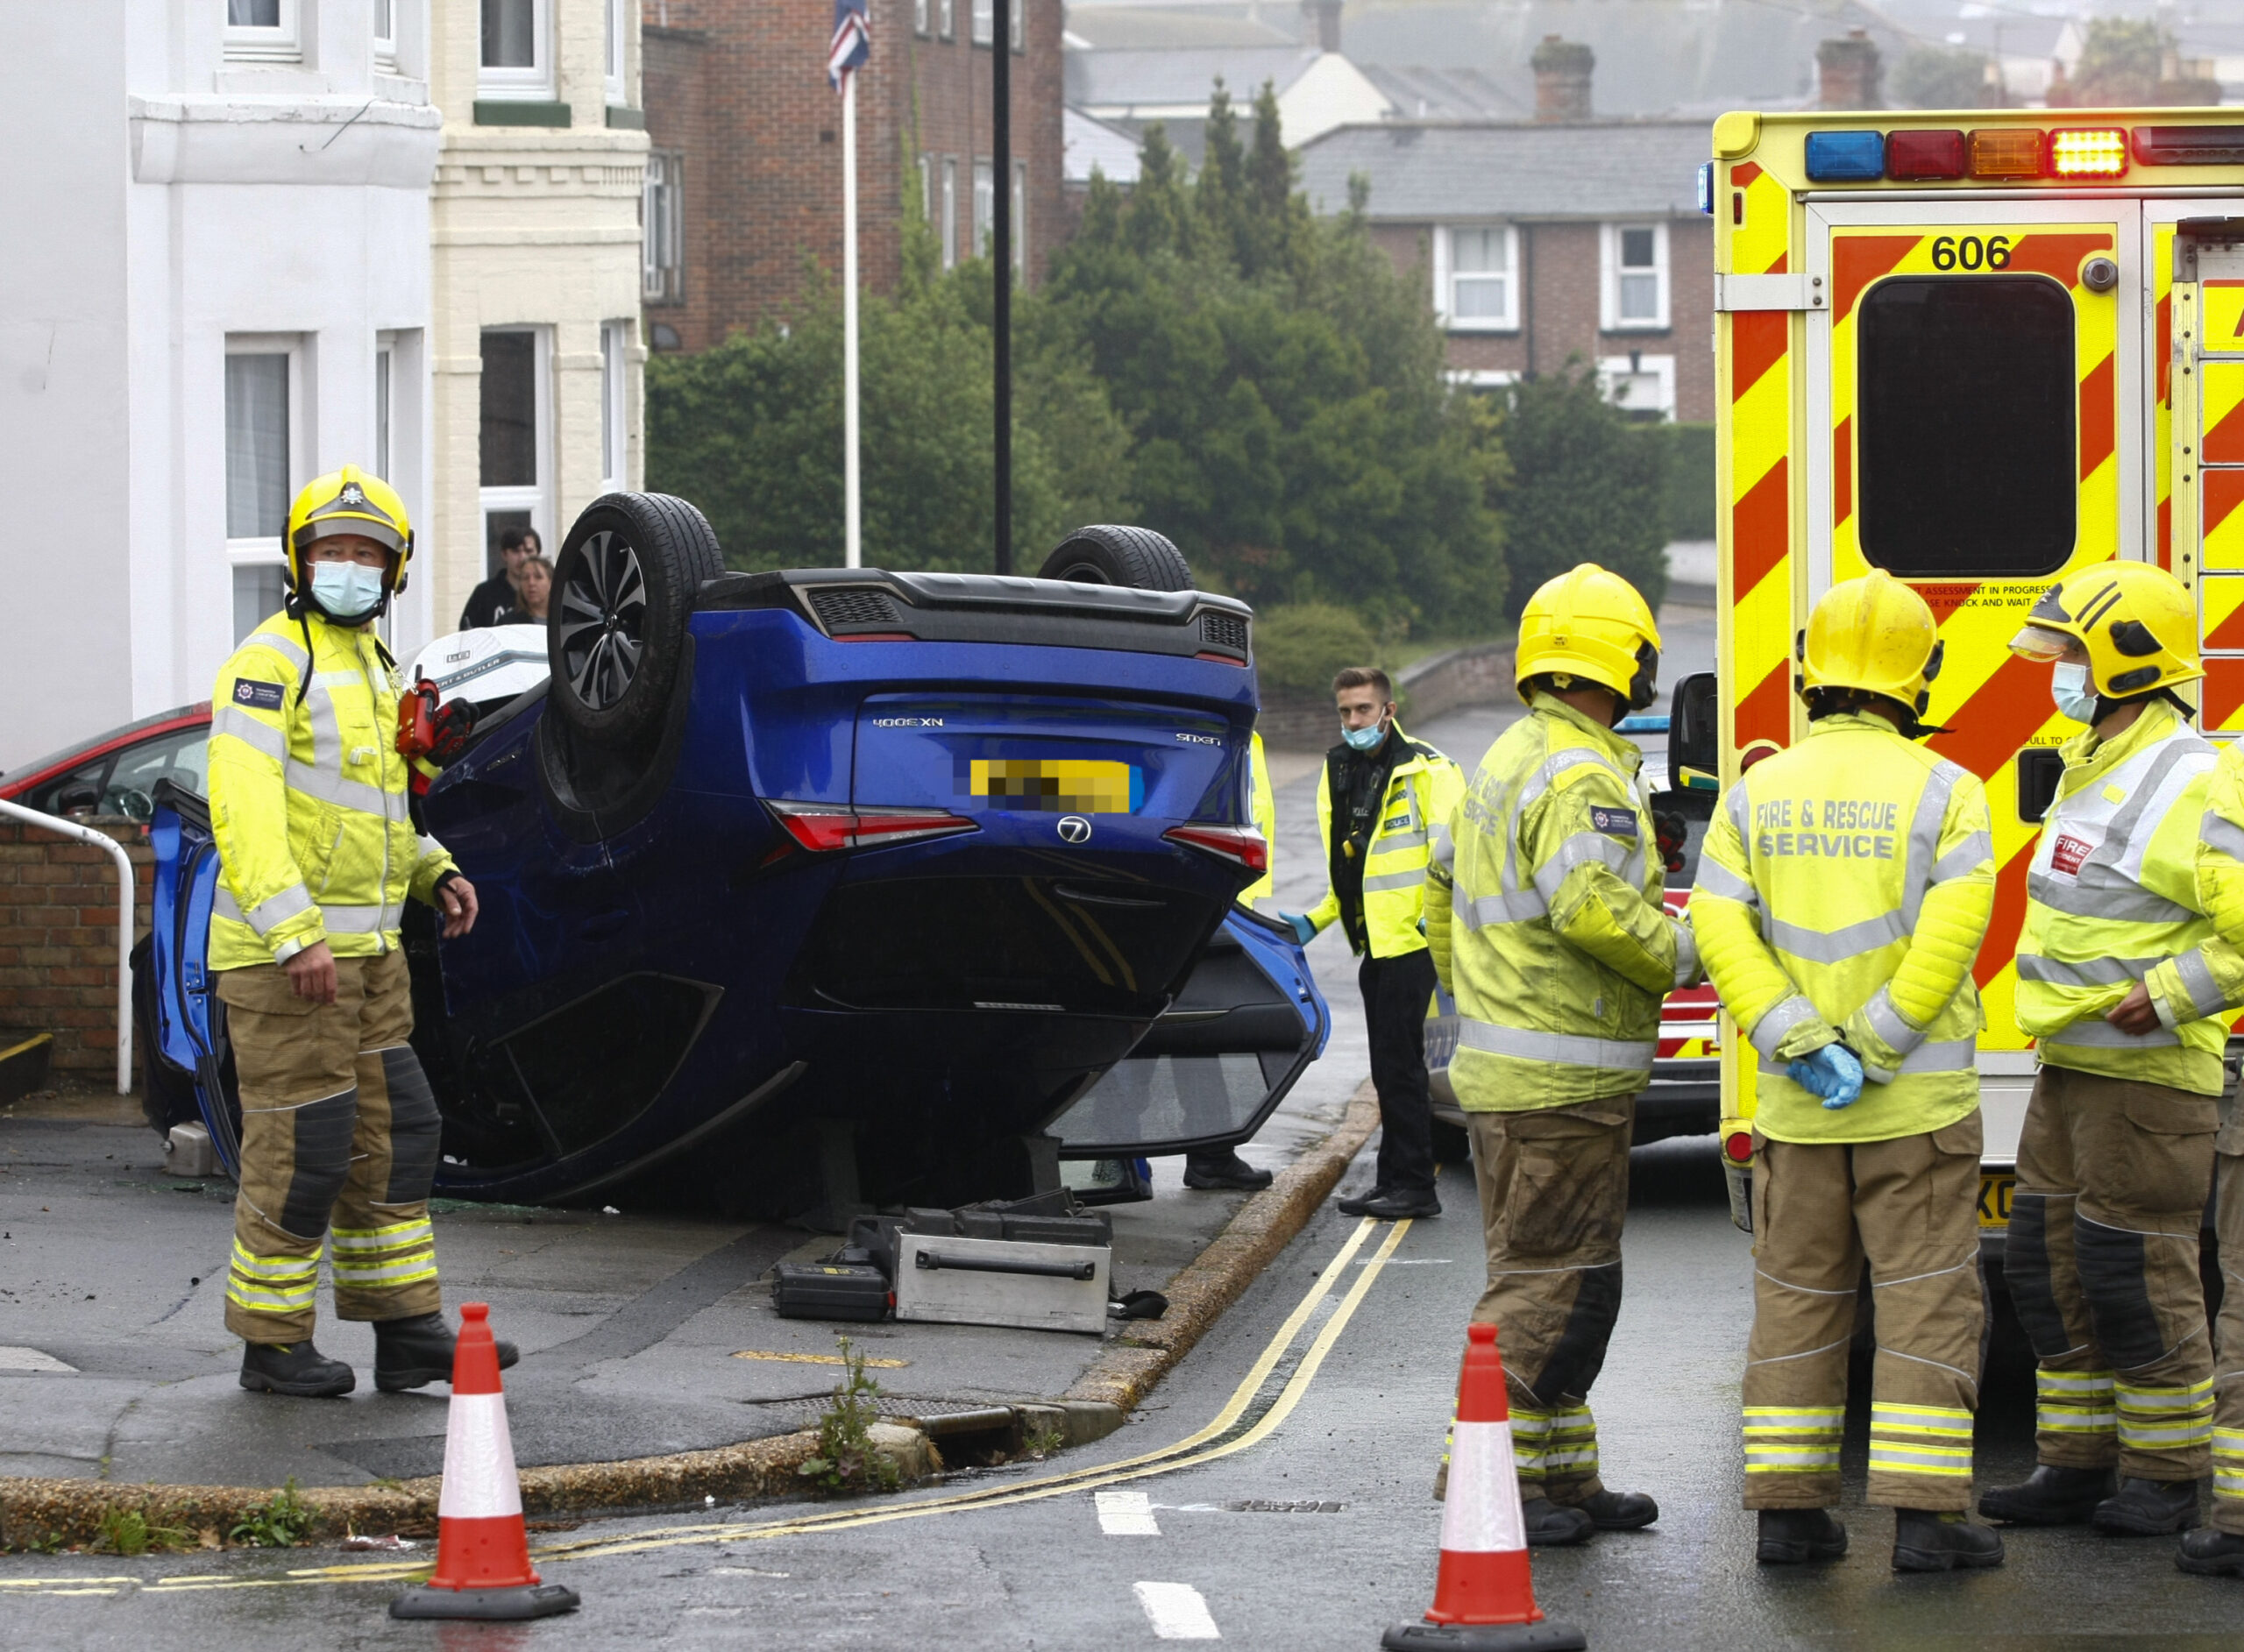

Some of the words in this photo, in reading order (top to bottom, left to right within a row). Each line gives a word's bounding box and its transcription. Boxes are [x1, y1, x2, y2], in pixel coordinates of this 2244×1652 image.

[1932, 236, 2011, 271] 606
[1926, 586, 1985, 595] ASSESSMENT
[1944, 599, 1978, 607] KNOCK
[920, 718, 944, 727] NX
[1175, 733, 1221, 747] LEXUS
[2049, 736, 2063, 745] TO
[1756, 799, 1792, 831] FIRE
[1801, 799, 1814, 828] &
[1823, 799, 1898, 832] RESCUE
[1758, 833, 1893, 860] SERVICE
[2056, 836, 2091, 857] FIRE
